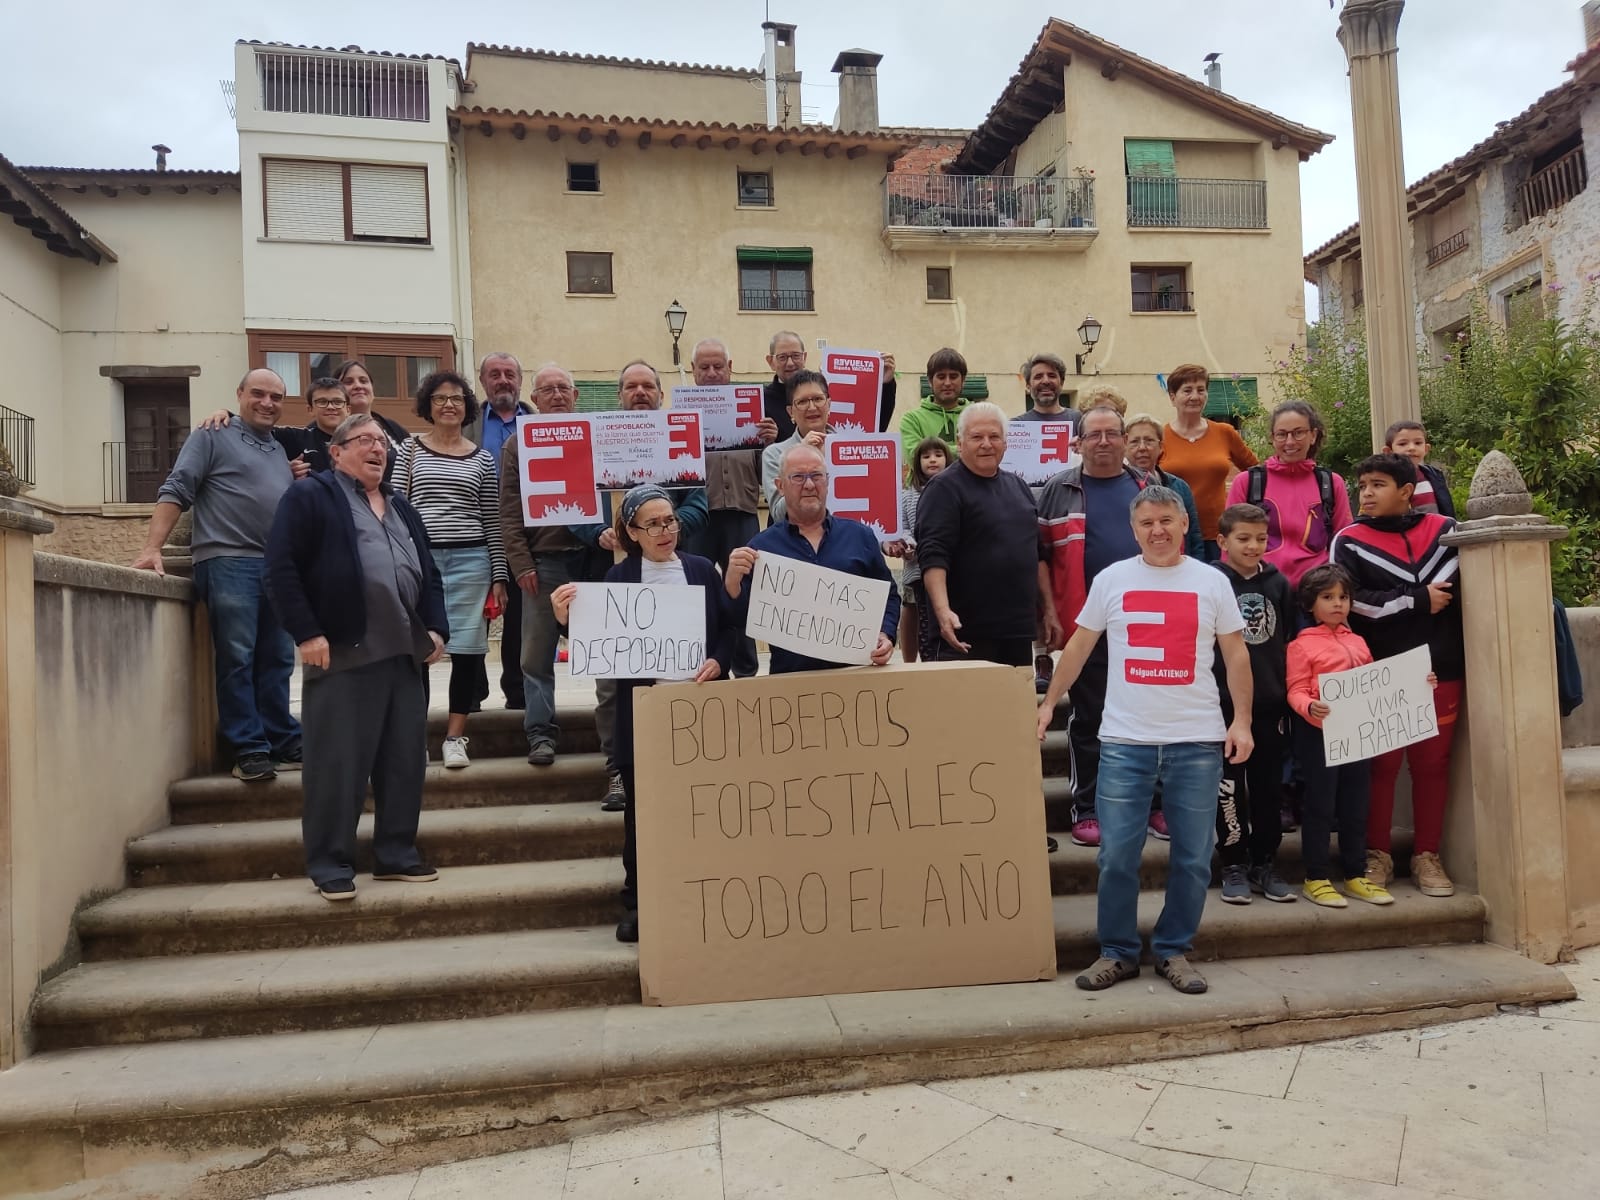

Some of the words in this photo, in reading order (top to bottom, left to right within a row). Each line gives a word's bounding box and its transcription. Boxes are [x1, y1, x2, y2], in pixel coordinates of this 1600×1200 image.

[531, 426, 584, 437] REVUELTA
[606, 422, 656, 430] DESPOBLACIÓN
[839, 445, 889, 455] REVUELTA
[761, 564, 795, 597] NO
[604, 586, 657, 631] NO
[754, 599, 873, 650] INCENDIOS
[1322, 666, 1391, 702] QUIERO
[1368, 688, 1409, 718] VIVIR
[670, 688, 909, 766] BOMBEROS
[1328, 740, 1351, 762] EN
[1358, 703, 1434, 750] RAFALES
[690, 762, 997, 839] FORESTALES
[684, 871, 828, 944] TODO
[849, 868, 901, 933] EL
[922, 853, 1021, 928] AÑO
